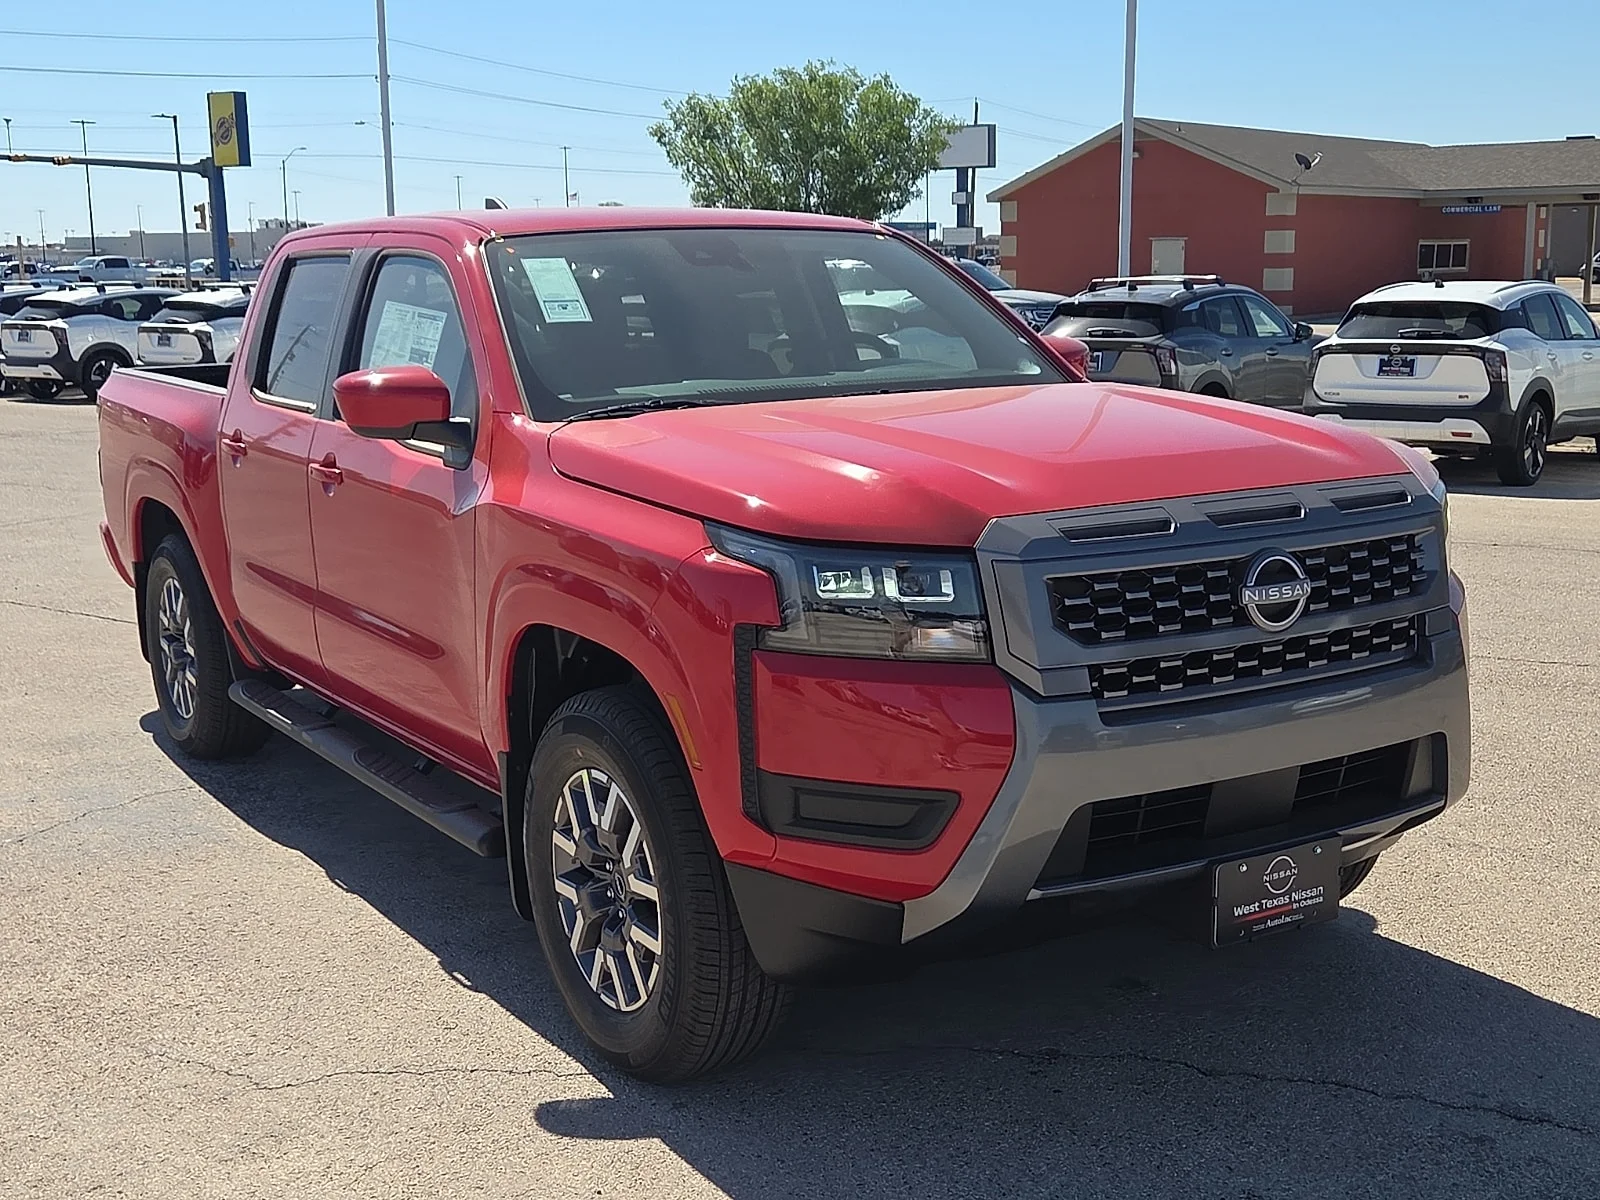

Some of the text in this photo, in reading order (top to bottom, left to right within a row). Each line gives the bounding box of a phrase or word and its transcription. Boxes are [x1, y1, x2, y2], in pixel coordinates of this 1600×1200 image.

[1245, 582, 1310, 602] NISSAN
[1263, 867, 1298, 882] NISSAN
[1233, 886, 1324, 917] West Texas Nissan
[1300, 896, 1324, 907] Odessa
